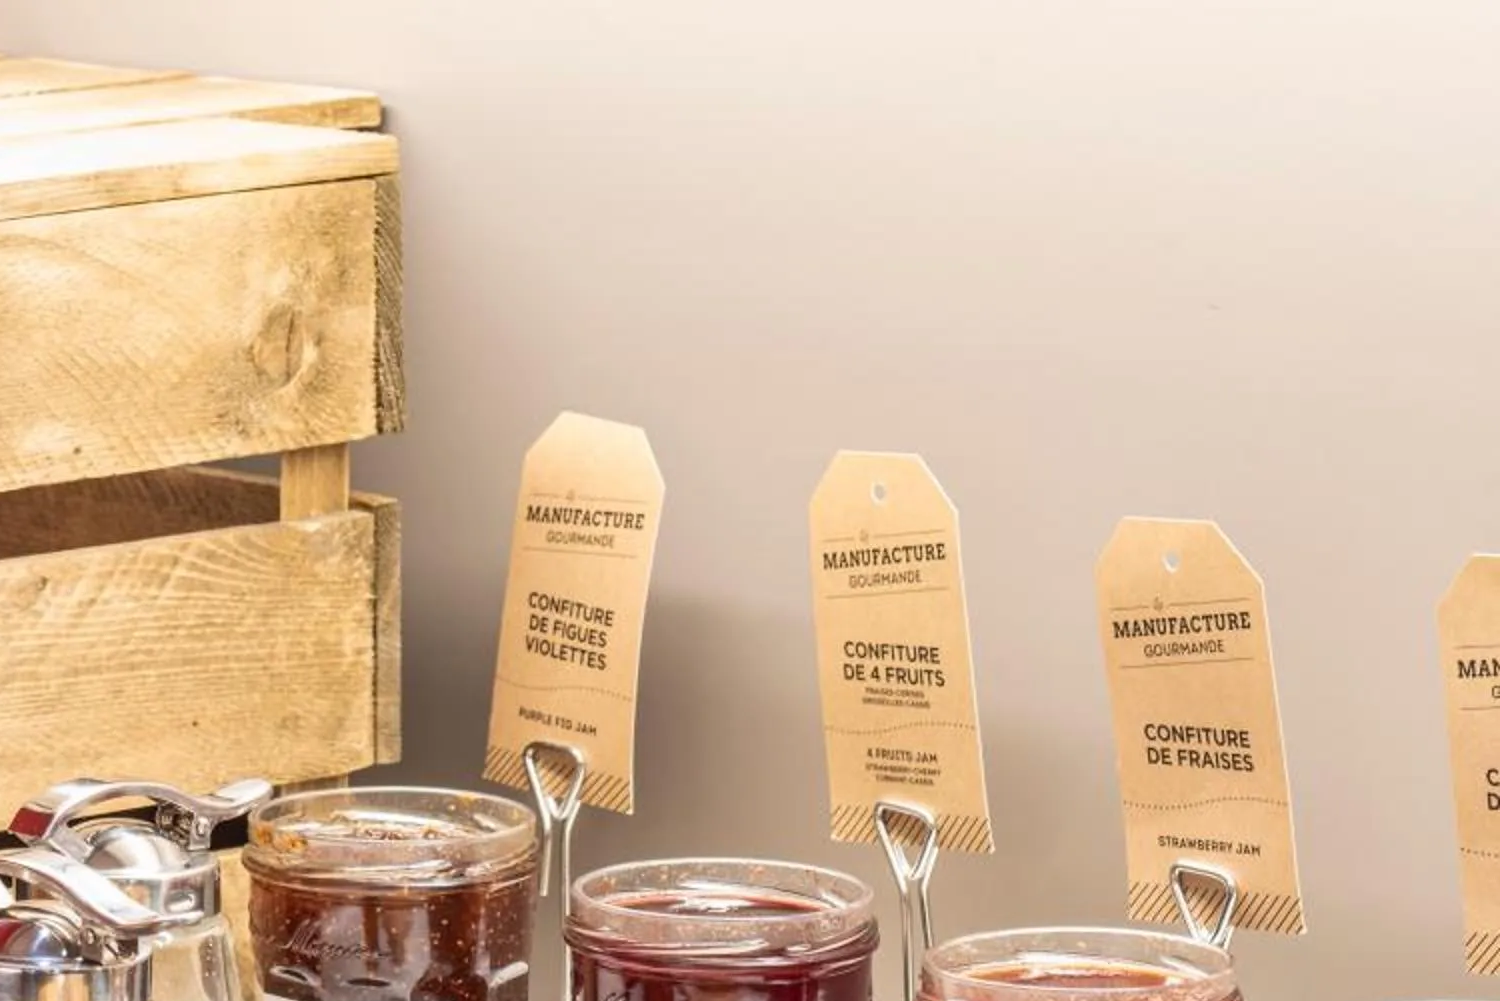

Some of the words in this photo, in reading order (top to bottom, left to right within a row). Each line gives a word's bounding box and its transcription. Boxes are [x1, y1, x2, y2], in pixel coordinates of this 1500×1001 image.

[526, 505, 646, 530] MANUFACTURE
[545, 530, 615, 549] GOURMANDE
[823, 543, 947, 571] MANUFACTURE
[848, 570, 922, 589] GOURMANDE
[528, 591, 615, 627] CONFITURE
[529, 614, 549, 634] DE
[553, 619, 608, 648] FIGUES
[1113, 611, 1251, 639] MANUFACTURE
[525, 635, 608, 671] VIOLETTES
[843, 641, 941, 664] CONFITURE
[1143, 639, 1226, 658] GOURMANDE
[843, 663, 866, 681] DE
[870, 665, 881, 682] 4
[885, 667, 946, 687] FRUITS
[518, 706, 551, 727] PURPLE
[575, 722, 597, 737] JAM
[1143, 723, 1251, 749] CONFITURE
[876, 748, 913, 762] FRUITS
[916, 752, 938, 764] JAM
[1146, 747, 1172, 766] DE
[1177, 749, 1255, 772] FRAISES
[1157, 835, 1233, 853] STRAWBERRY
[1236, 843, 1261, 857] JAM
